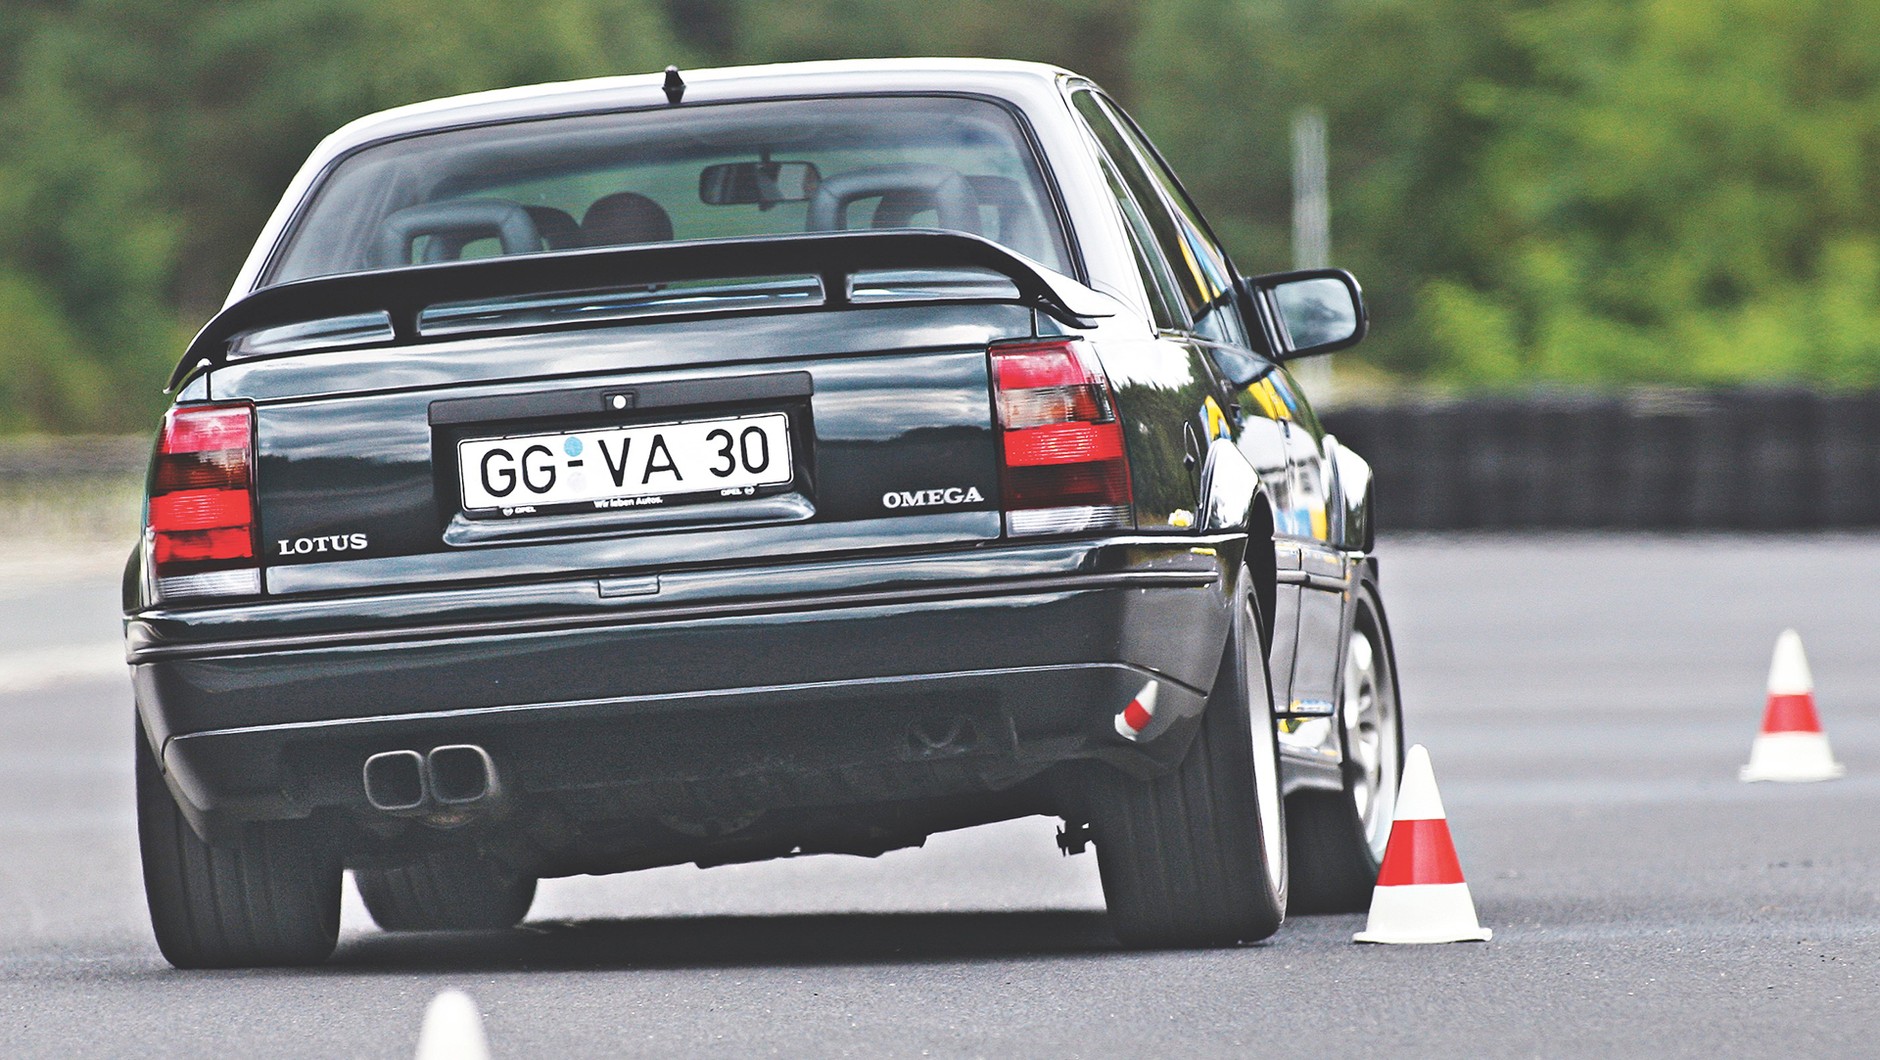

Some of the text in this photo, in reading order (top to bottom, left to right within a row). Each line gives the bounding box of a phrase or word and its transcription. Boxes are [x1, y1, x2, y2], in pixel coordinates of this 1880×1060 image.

[705, 425, 770, 478] 30
[882, 486, 985, 509] OMEGA
[277, 533, 368, 555] LOTUS
